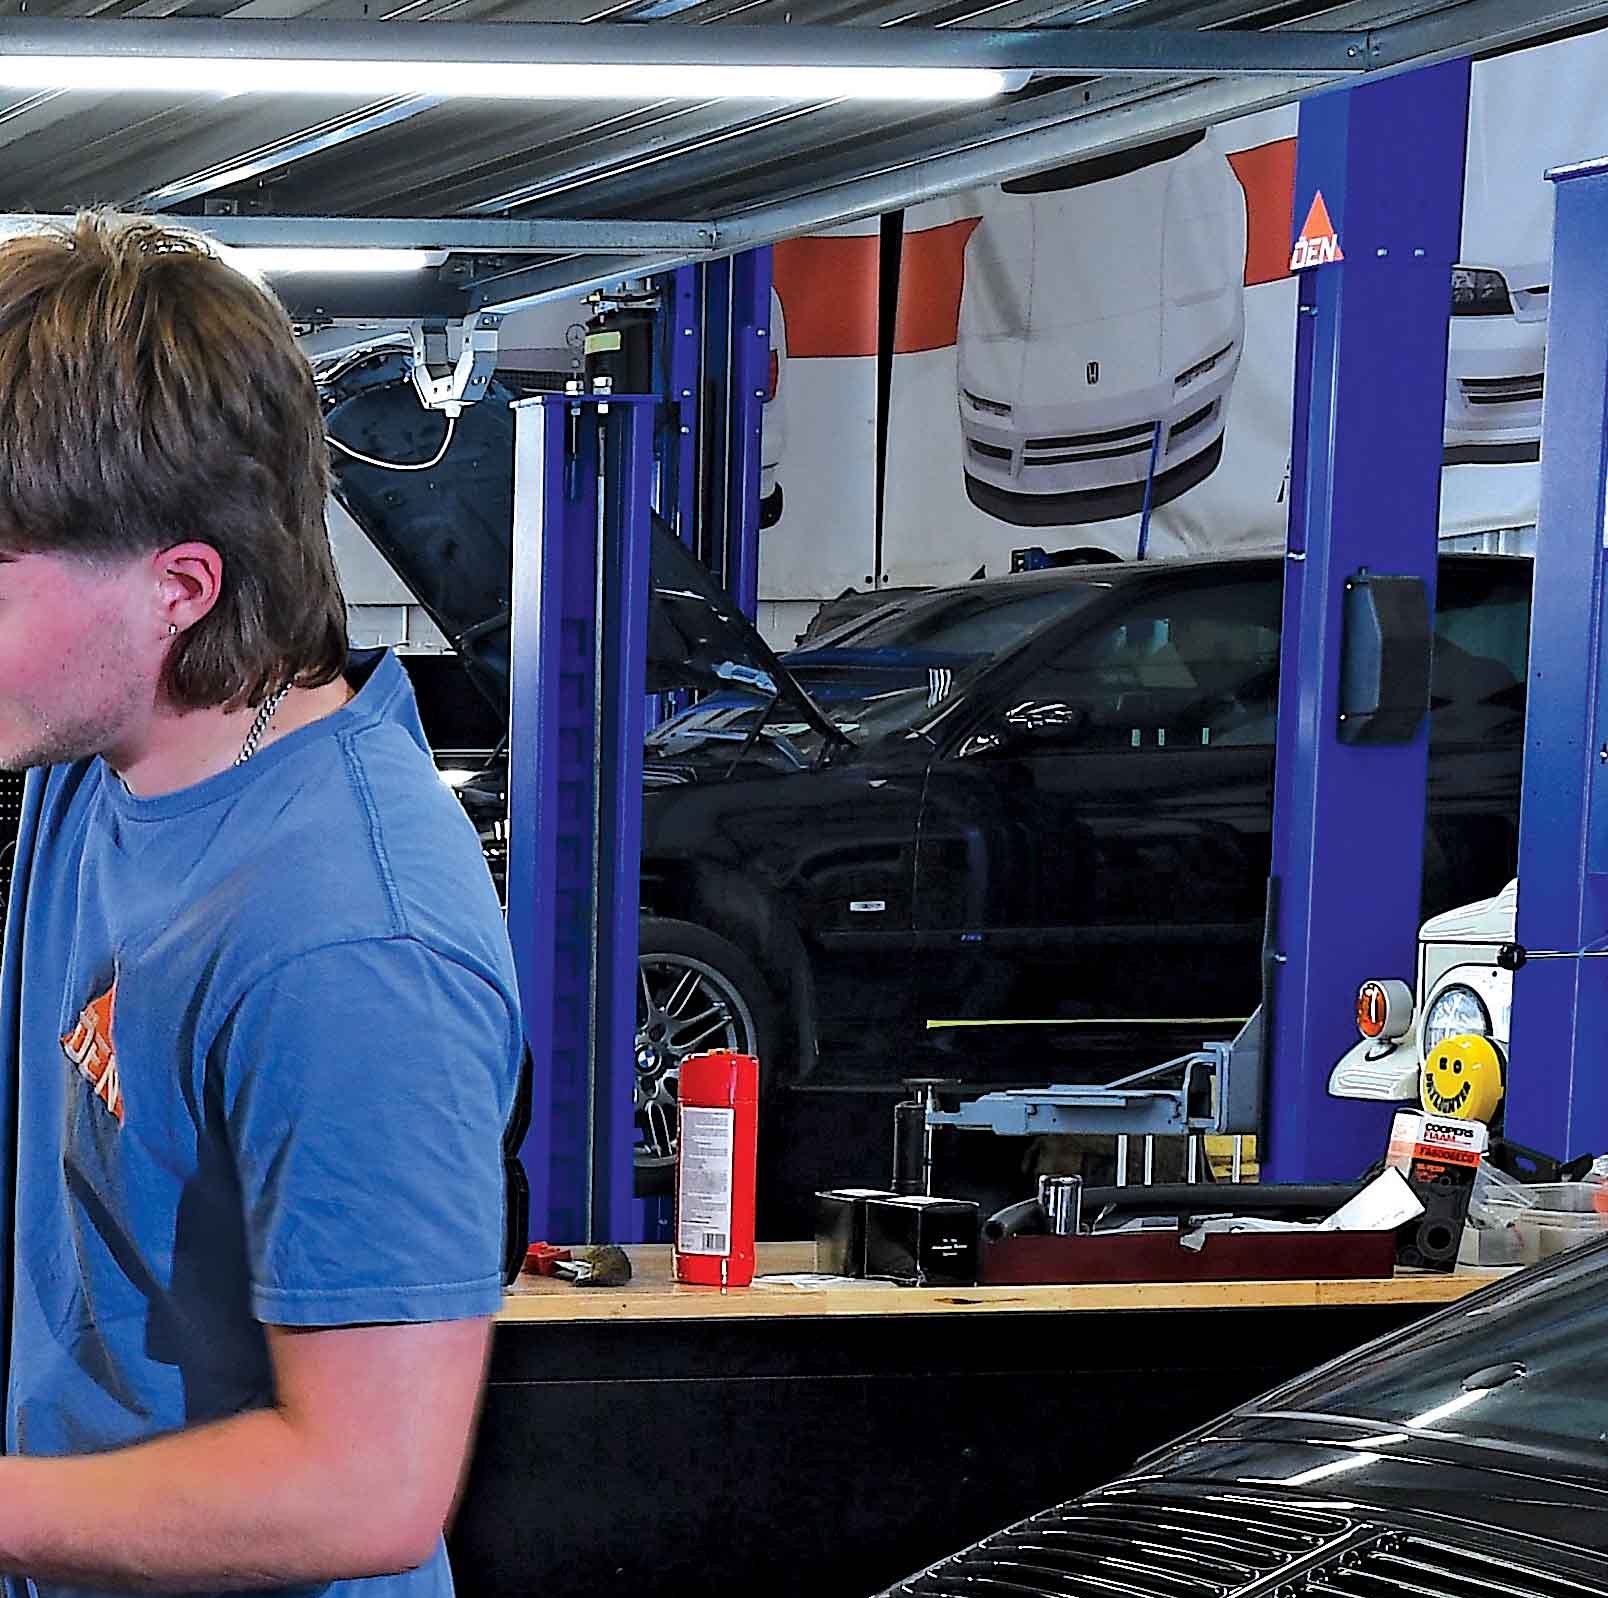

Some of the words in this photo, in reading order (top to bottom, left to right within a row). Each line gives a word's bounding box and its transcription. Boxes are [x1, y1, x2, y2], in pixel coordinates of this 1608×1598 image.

[1290, 234, 1337, 270] DEN
[65, 1018, 119, 1112] DEN
[1425, 1122, 1474, 1137] COOPERS
